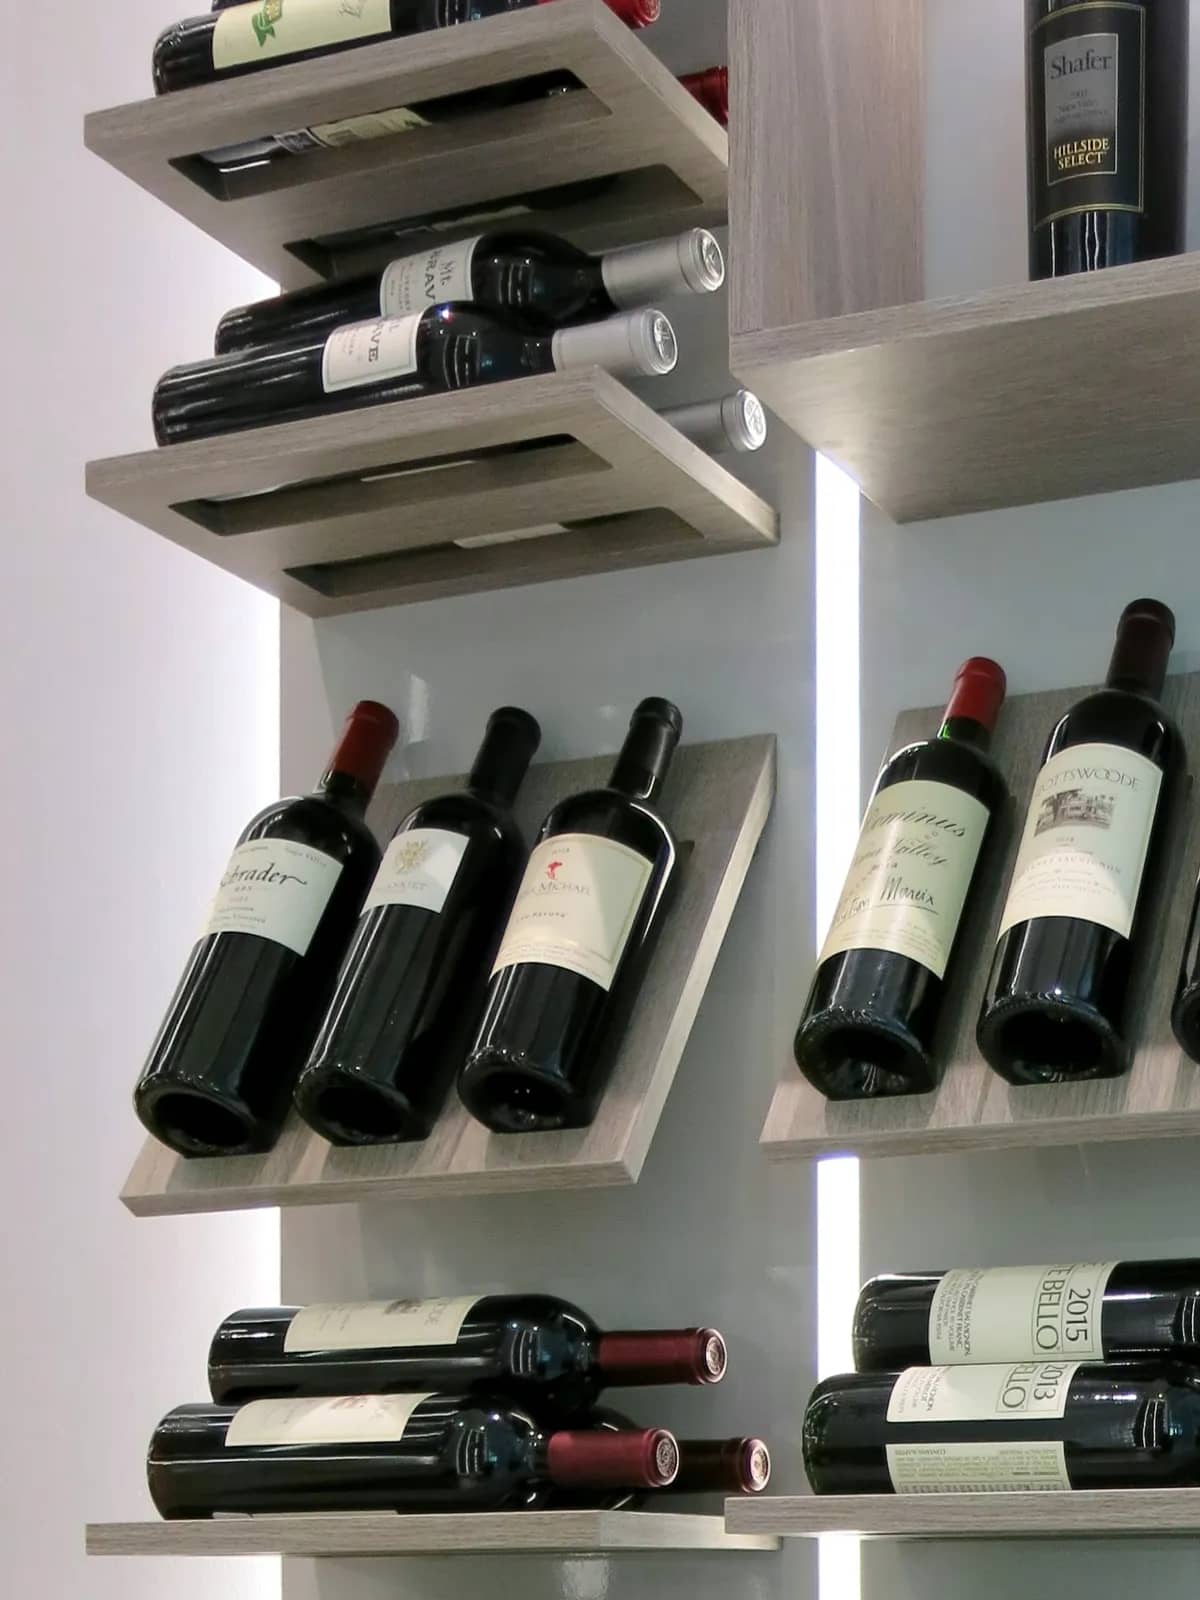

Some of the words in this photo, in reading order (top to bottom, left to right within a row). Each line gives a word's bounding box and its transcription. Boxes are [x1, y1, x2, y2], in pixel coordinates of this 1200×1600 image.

[1050, 49, 1113, 80] Shafer
[1053, 137, 1110, 160] HILLSIDE
[1057, 151, 1107, 170] SELECT
[1035, 1279, 1066, 1351] BELLO
[1065, 1287, 1093, 1343] 2015
[1002, 1363, 1036, 1409] ELLO
